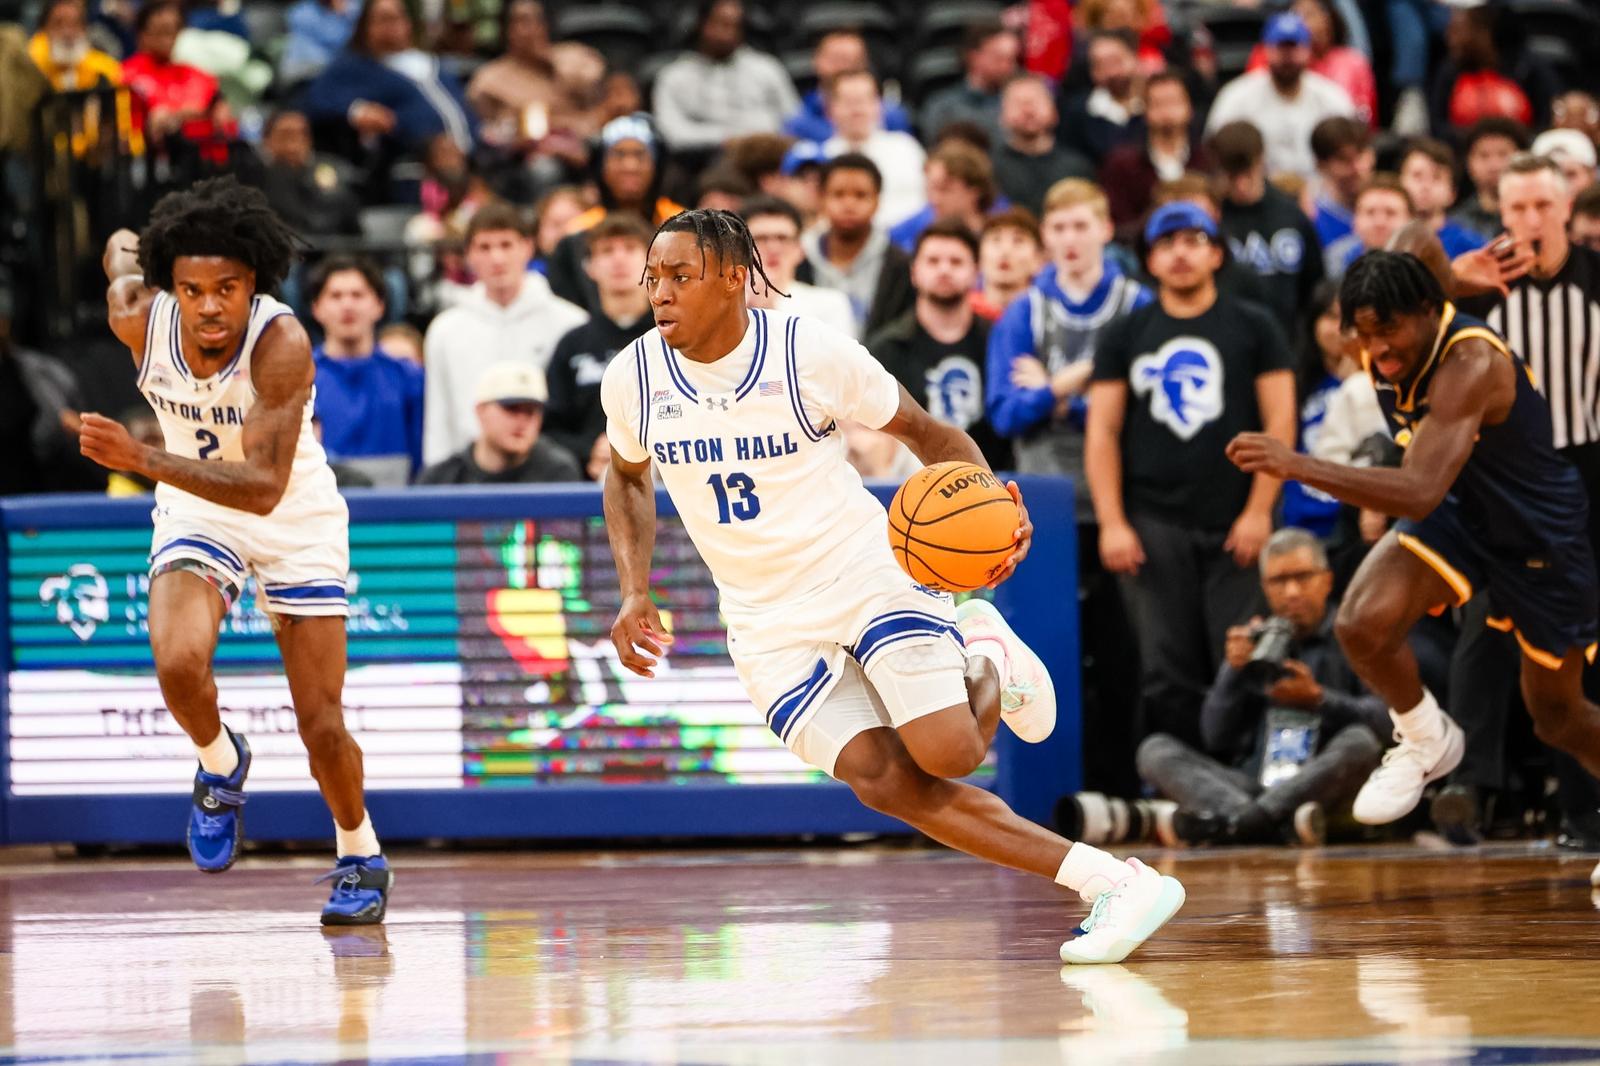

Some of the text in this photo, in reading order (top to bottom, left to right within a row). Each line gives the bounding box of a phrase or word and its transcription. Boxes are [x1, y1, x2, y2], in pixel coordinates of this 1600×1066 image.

[148, 390, 203, 422] SETON
[195, 428, 223, 461] 2
[653, 432, 798, 465] SETON HALL
[706, 471, 761, 525] 13
[100, 707, 171, 736] THE
